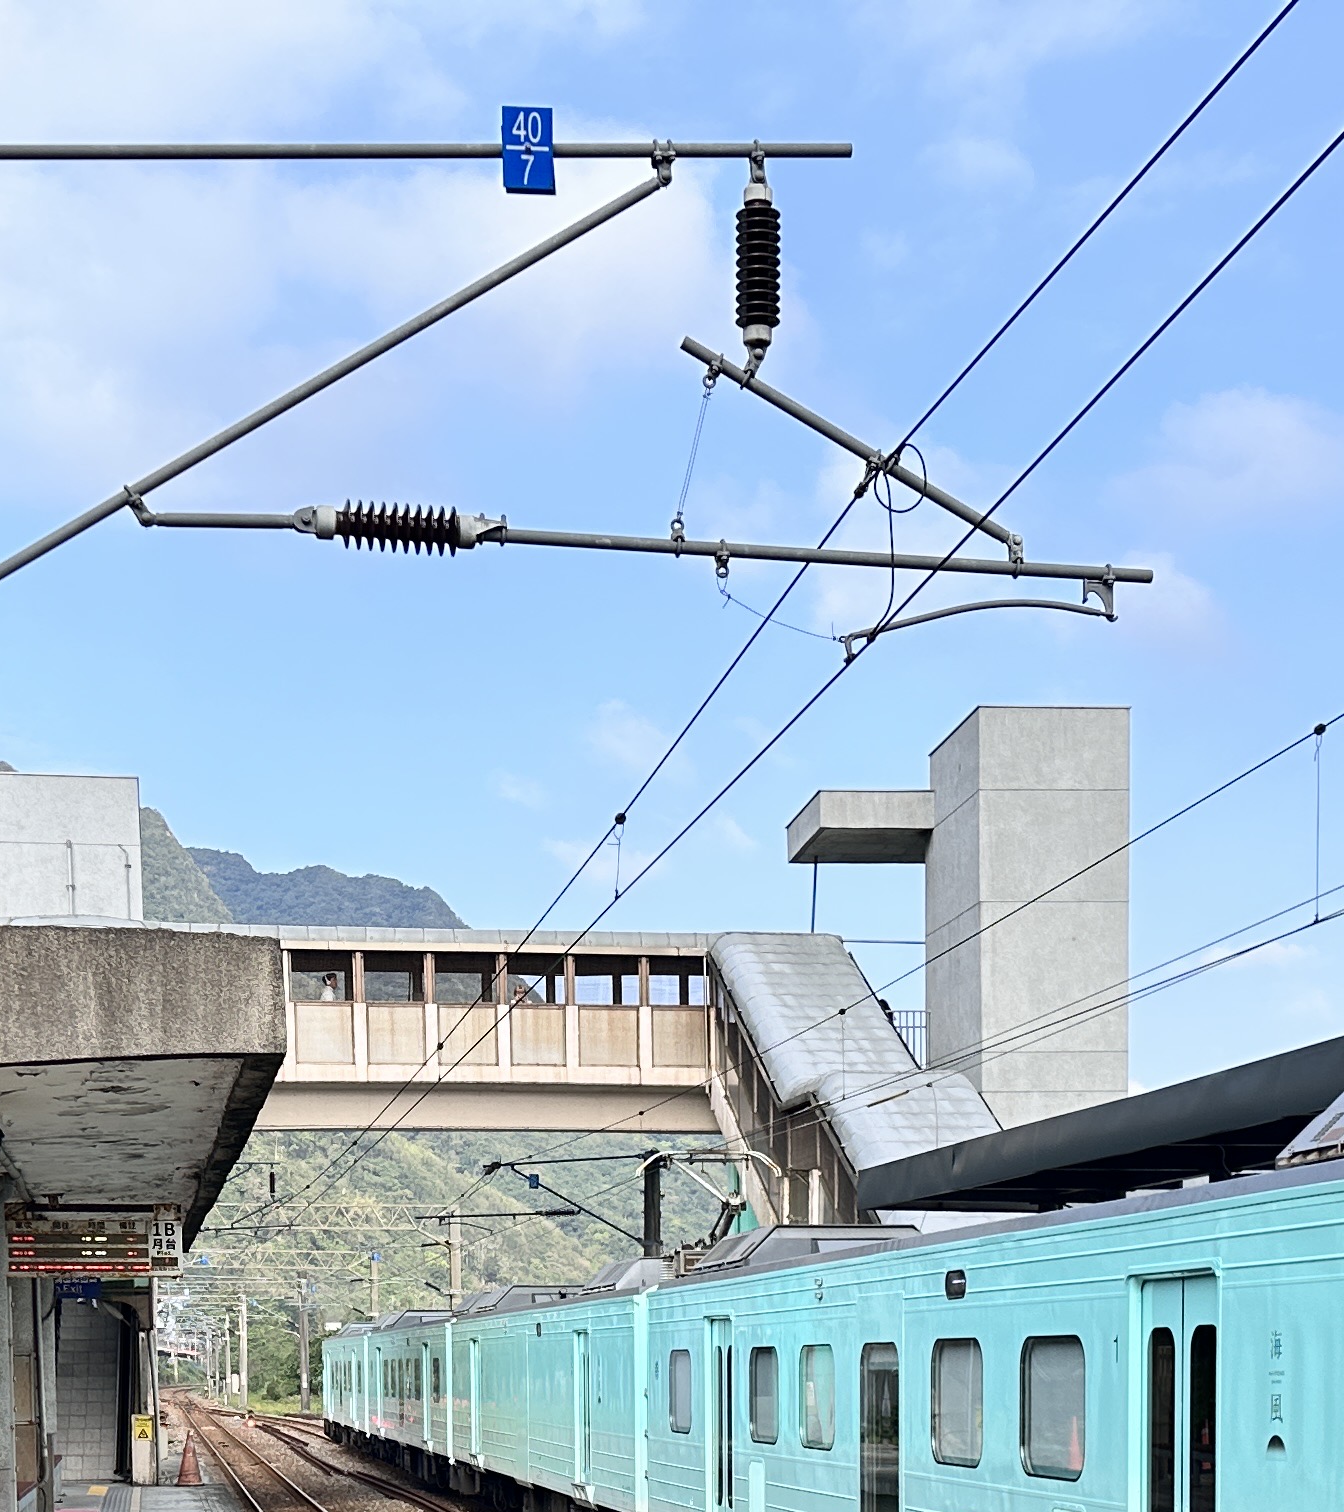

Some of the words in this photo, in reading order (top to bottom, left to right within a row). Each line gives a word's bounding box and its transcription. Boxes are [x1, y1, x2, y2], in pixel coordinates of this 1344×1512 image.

[512, 111, 542, 143] 40
[520, 154, 535, 185] 7
[152, 1222, 176, 1236] 1B
[151, 1238, 176, 1250] 月台
